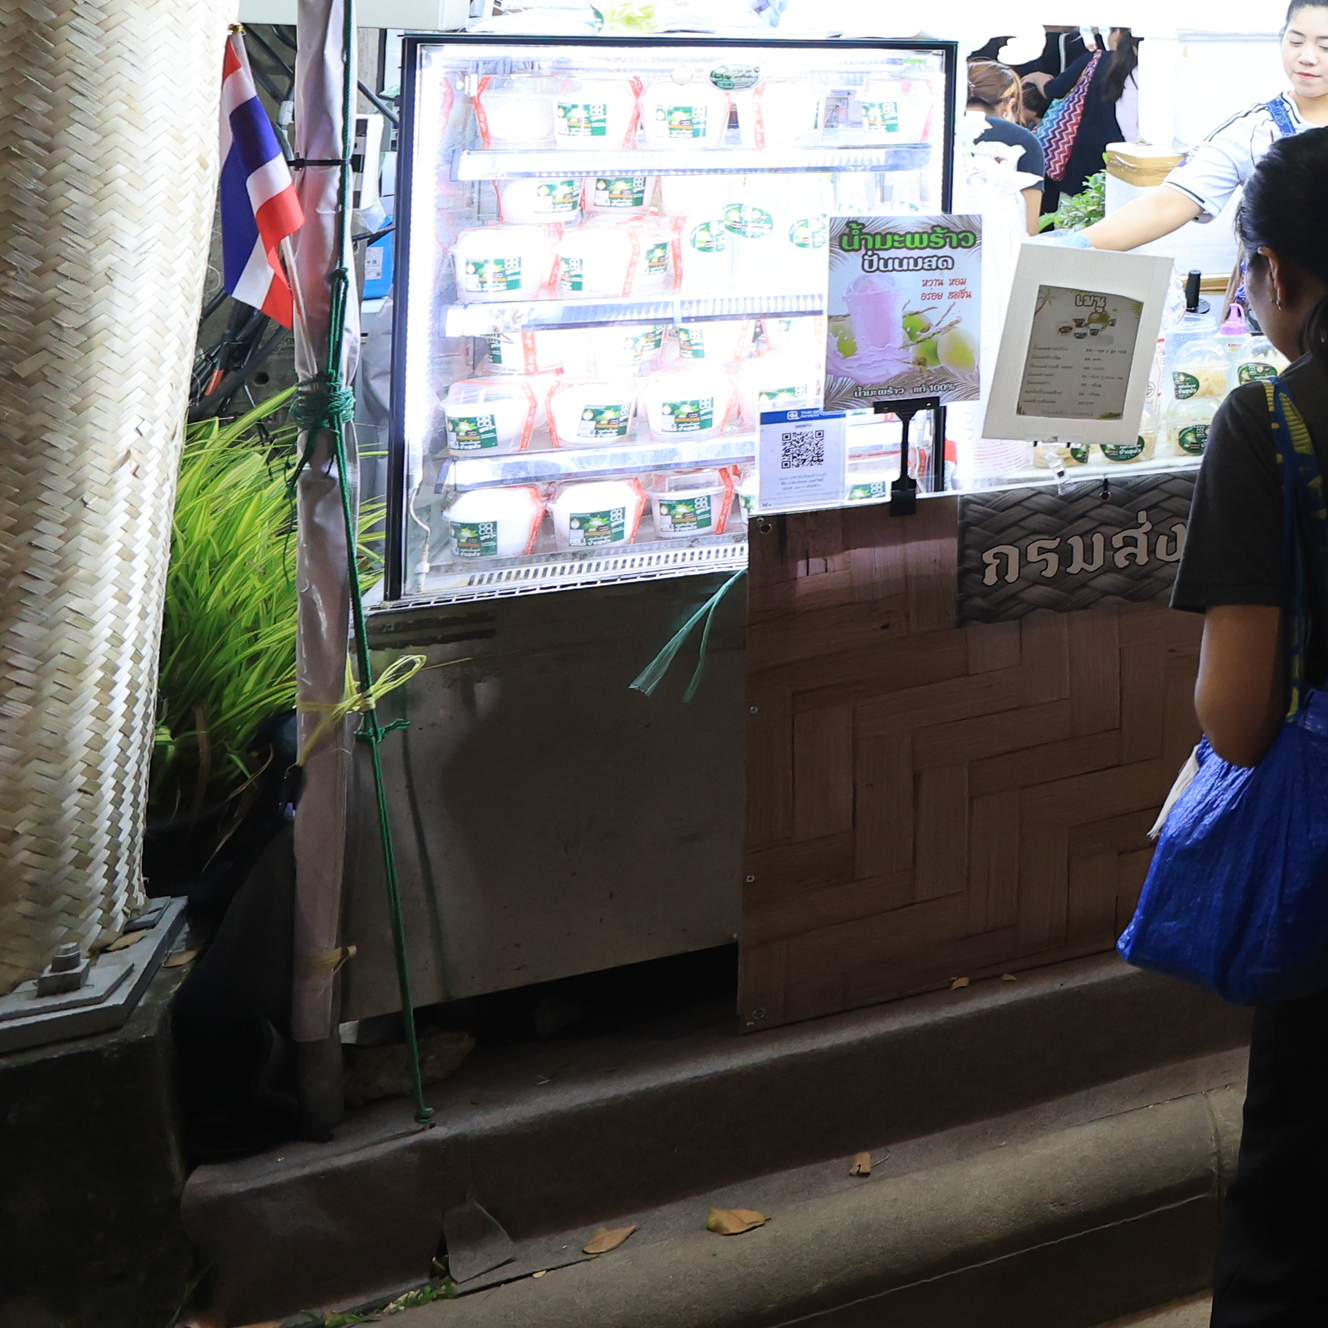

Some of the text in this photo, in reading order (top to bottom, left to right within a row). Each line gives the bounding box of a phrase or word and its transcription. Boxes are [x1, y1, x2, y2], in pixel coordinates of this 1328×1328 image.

[840, 222, 976, 252] น้ำมะพร้าว
[862, 251, 954, 273] ปั่นนมสด
[921, 277, 967, 287] หวาน หอม
[1074, 293, 1107, 313] เมนู
[854, 385, 905, 399] น้ำมะพร้าว
[929, 383, 956, 393] 100%
